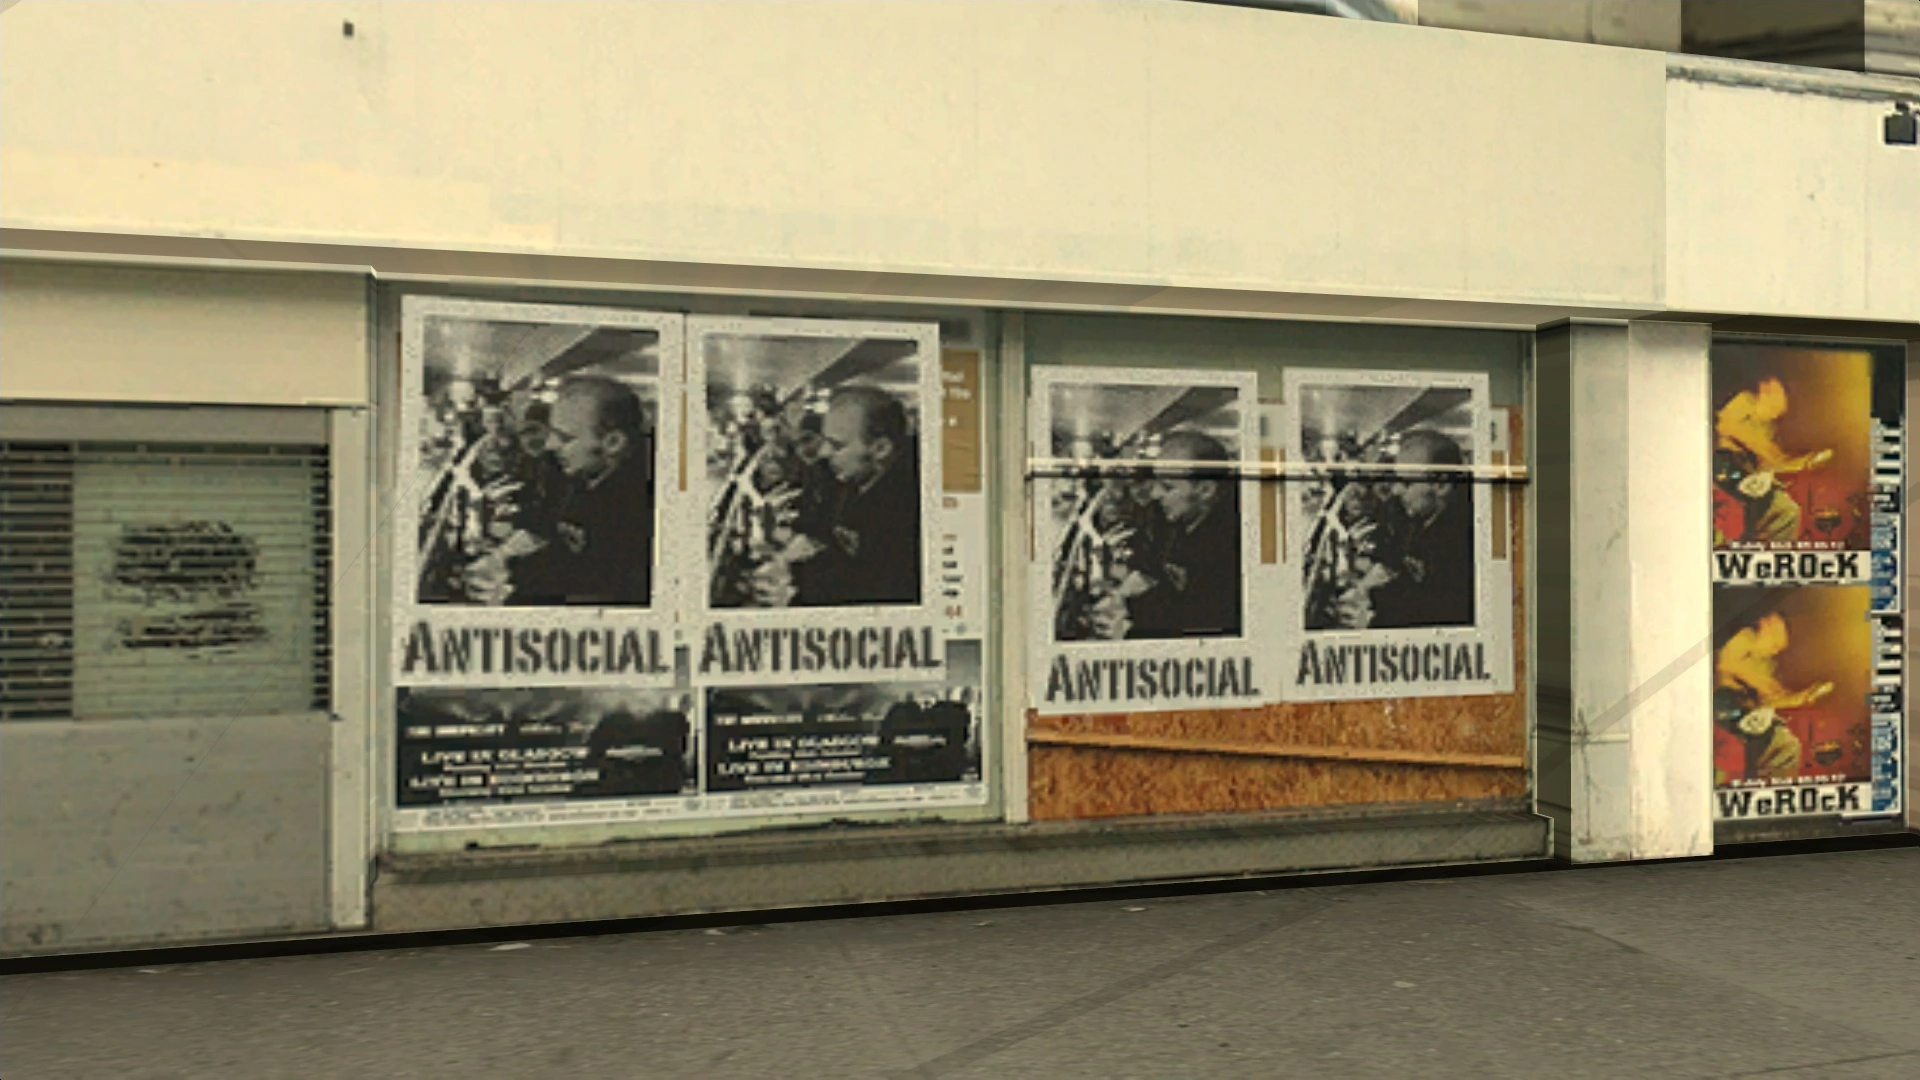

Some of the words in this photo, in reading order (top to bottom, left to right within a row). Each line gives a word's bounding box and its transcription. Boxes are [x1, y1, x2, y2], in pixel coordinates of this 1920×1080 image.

[403, 621, 670, 674] ANTISOCIAL
[701, 622, 943, 673] ANTISOCIAL
[1296, 640, 1491, 686] ANTISOCIAL
[1046, 654, 1260, 702] ANTISOCIAL
